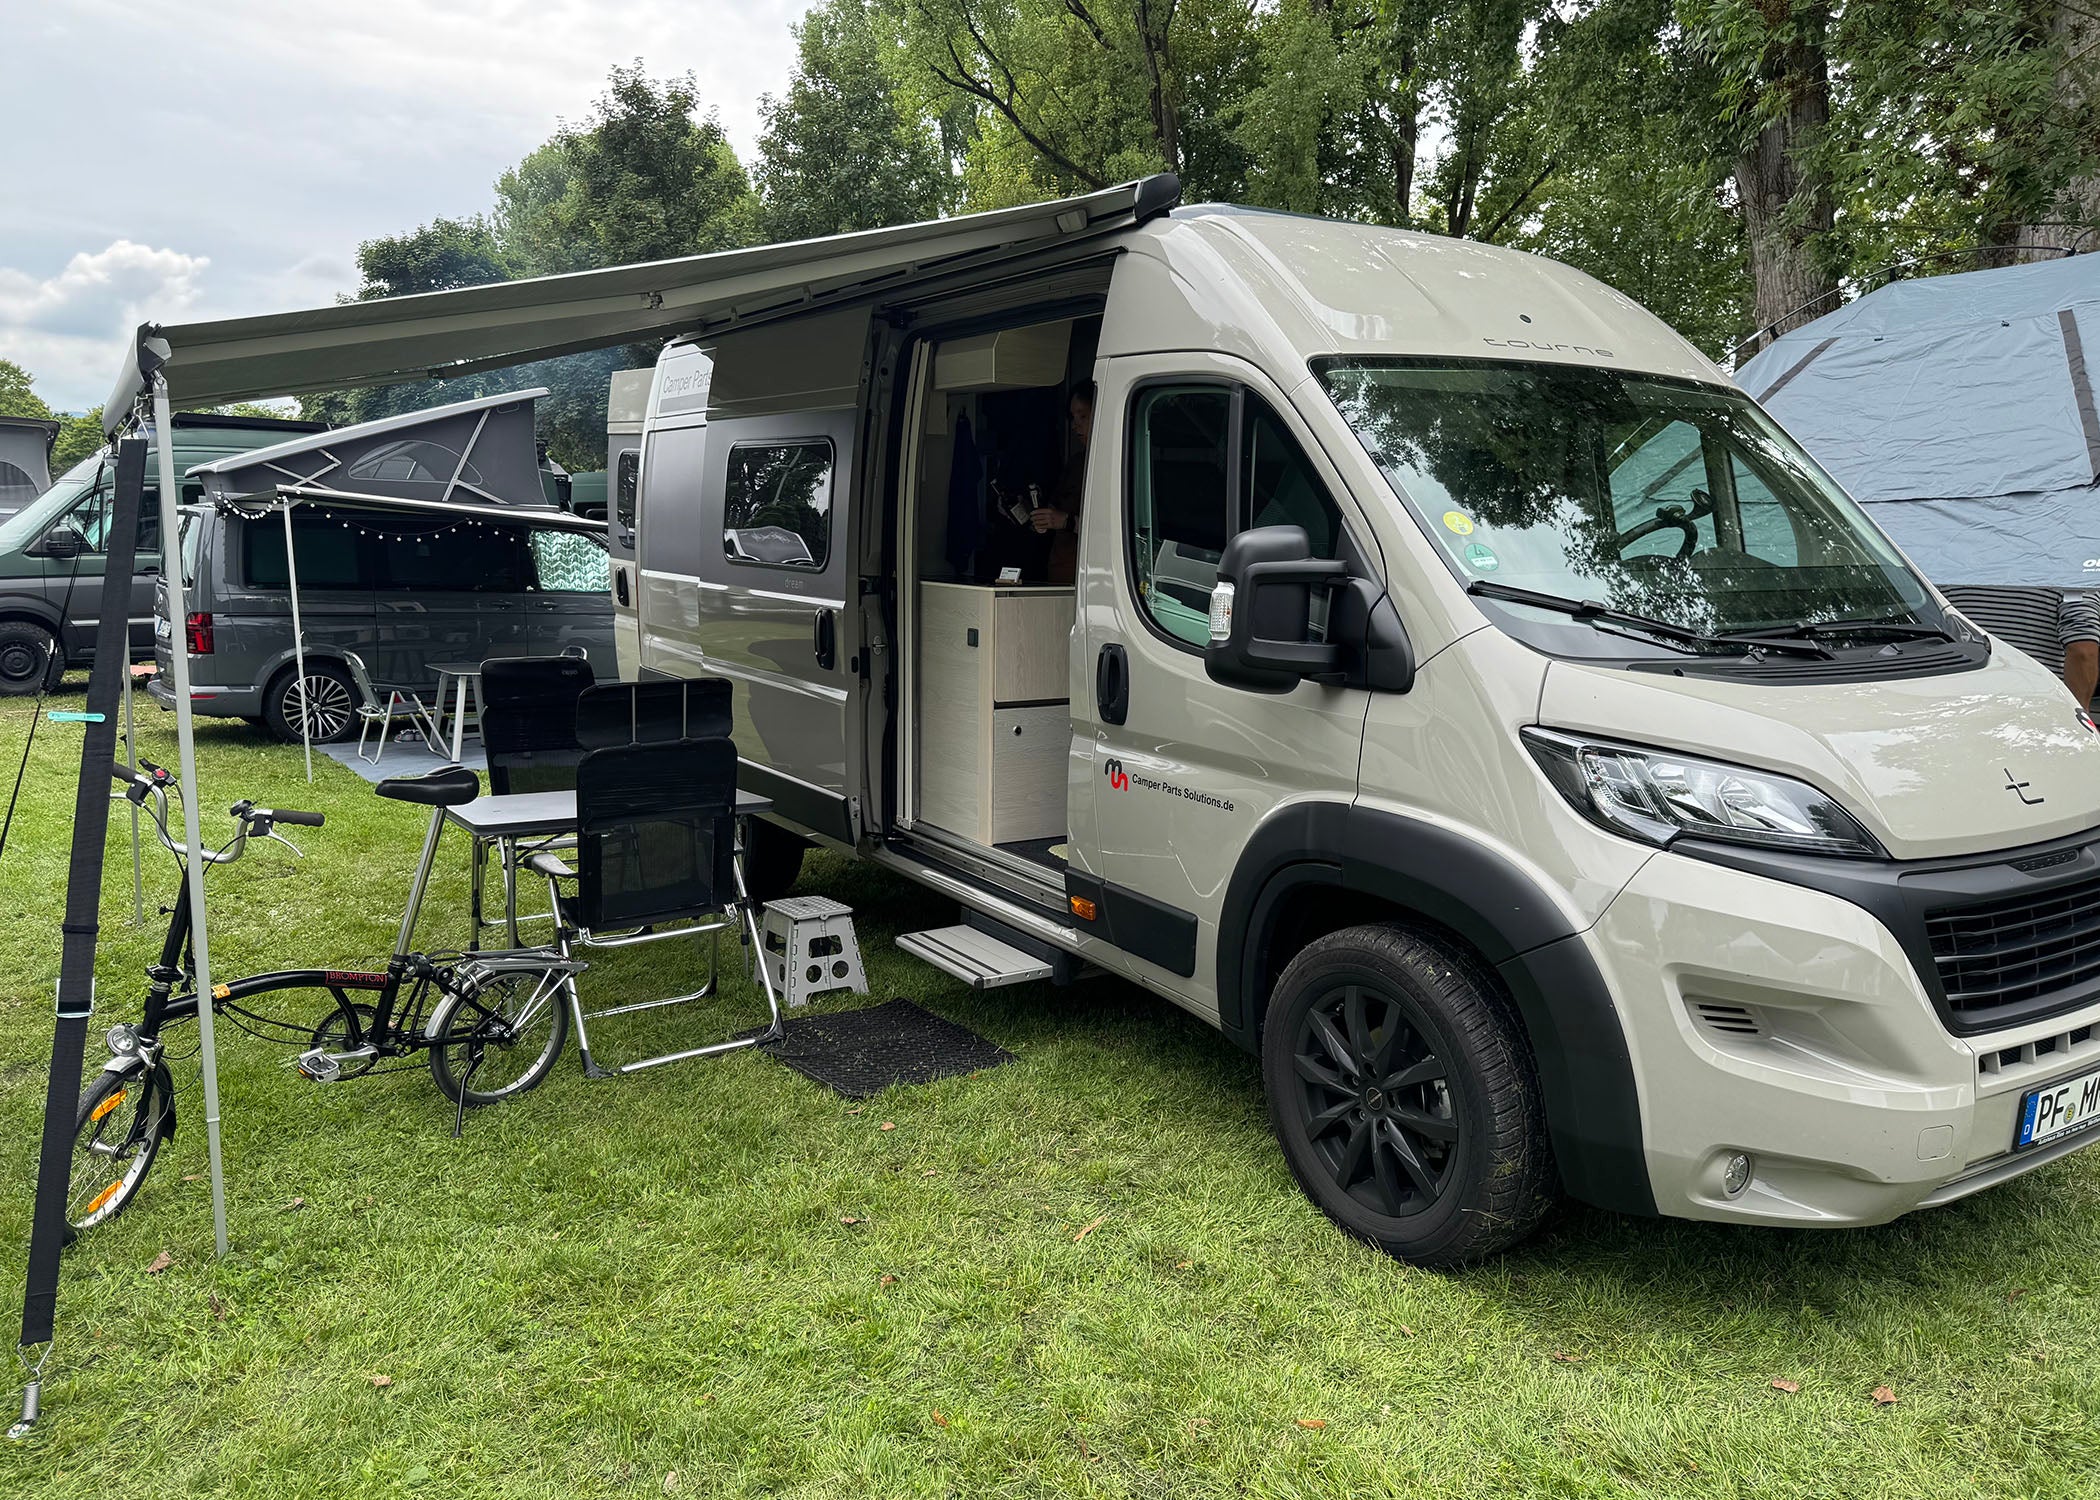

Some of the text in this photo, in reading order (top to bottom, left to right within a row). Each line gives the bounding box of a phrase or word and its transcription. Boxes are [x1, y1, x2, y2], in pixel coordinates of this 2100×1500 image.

[1483, 338, 1614, 358] tourne
[663, 376, 692, 395] Camper
[1132, 774, 1234, 812] Camper Parts Solutions.de
[329, 971, 384, 982] BROMPTON
[2036, 1087, 2070, 1134] PF
[2023, 1124, 2031, 1136] D
